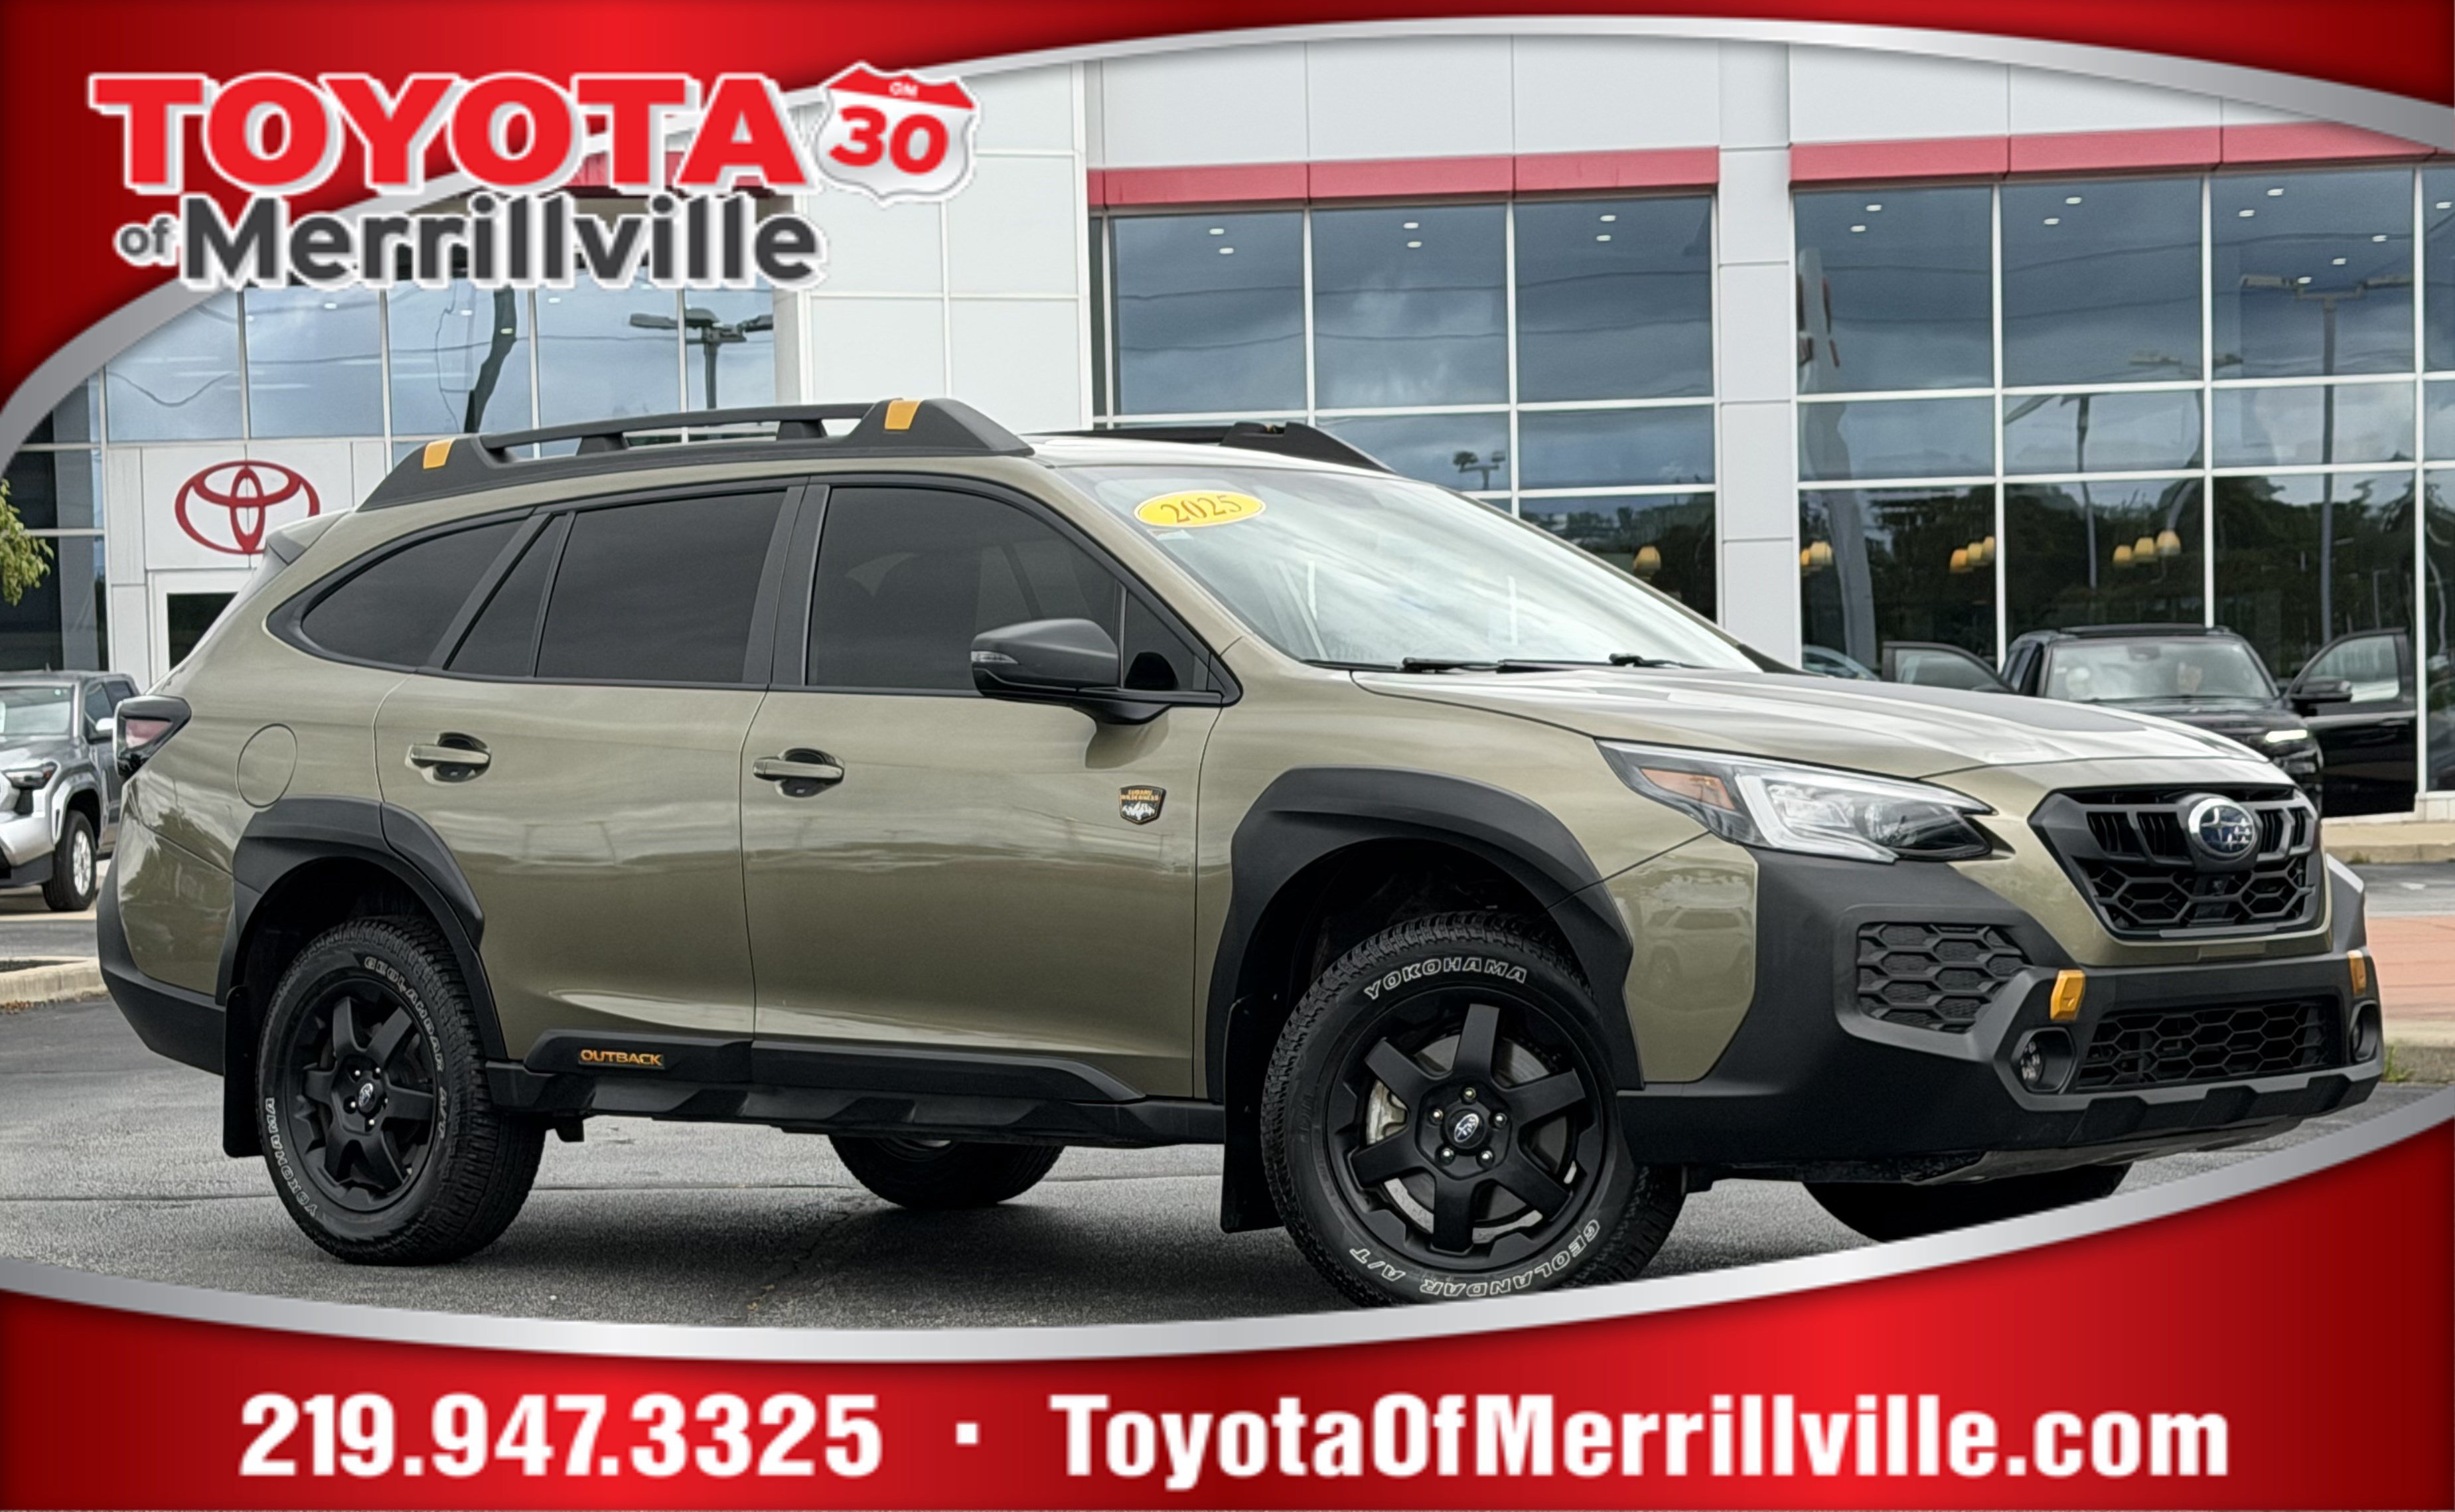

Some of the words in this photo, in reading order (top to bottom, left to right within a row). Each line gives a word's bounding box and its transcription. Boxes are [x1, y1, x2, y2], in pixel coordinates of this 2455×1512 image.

[1160, 494, 1242, 523] 2025
[1364, 957, 1526, 1000] YOKOHAMA
[580, 1049, 662, 1065] OUTBACK
[265, 1097, 318, 1217] YOKOHAMA
[1349, 1248, 1406, 1282] A/T
[1419, 1219, 1600, 1298] GEOLANDAR
